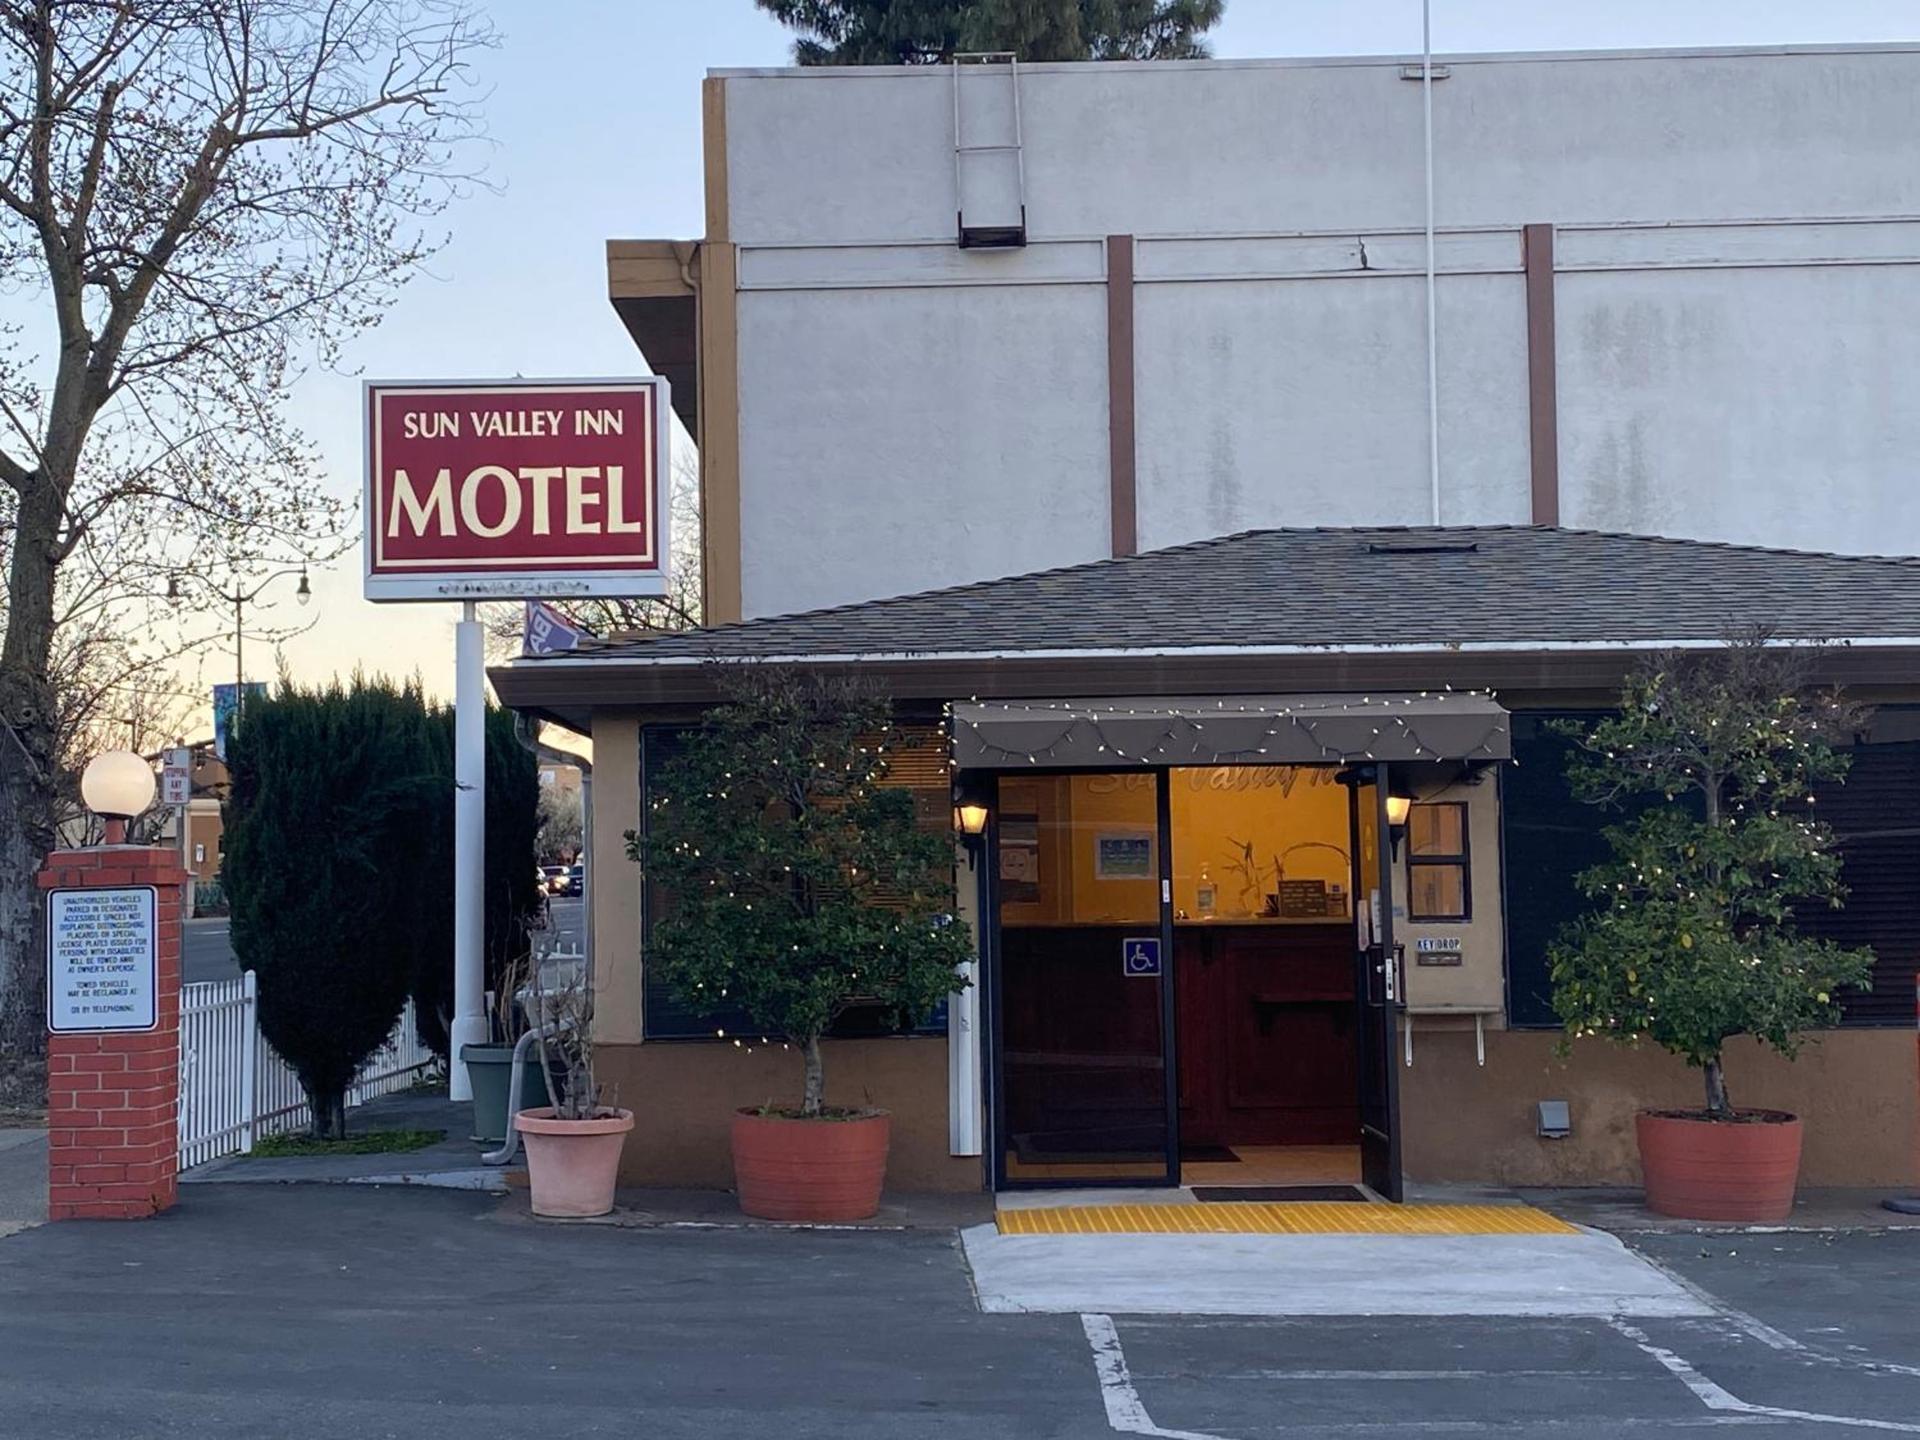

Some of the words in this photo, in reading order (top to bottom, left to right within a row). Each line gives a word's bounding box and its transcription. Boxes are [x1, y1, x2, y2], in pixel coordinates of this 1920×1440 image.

[404, 412, 459, 438] SUN
[471, 411, 563, 436] VALLEY
[575, 410, 622, 436] INN
[388, 466, 640, 538] MOTEL
[1418, 939, 1434, 950] KEY
[1437, 938, 1460, 949] DROP
